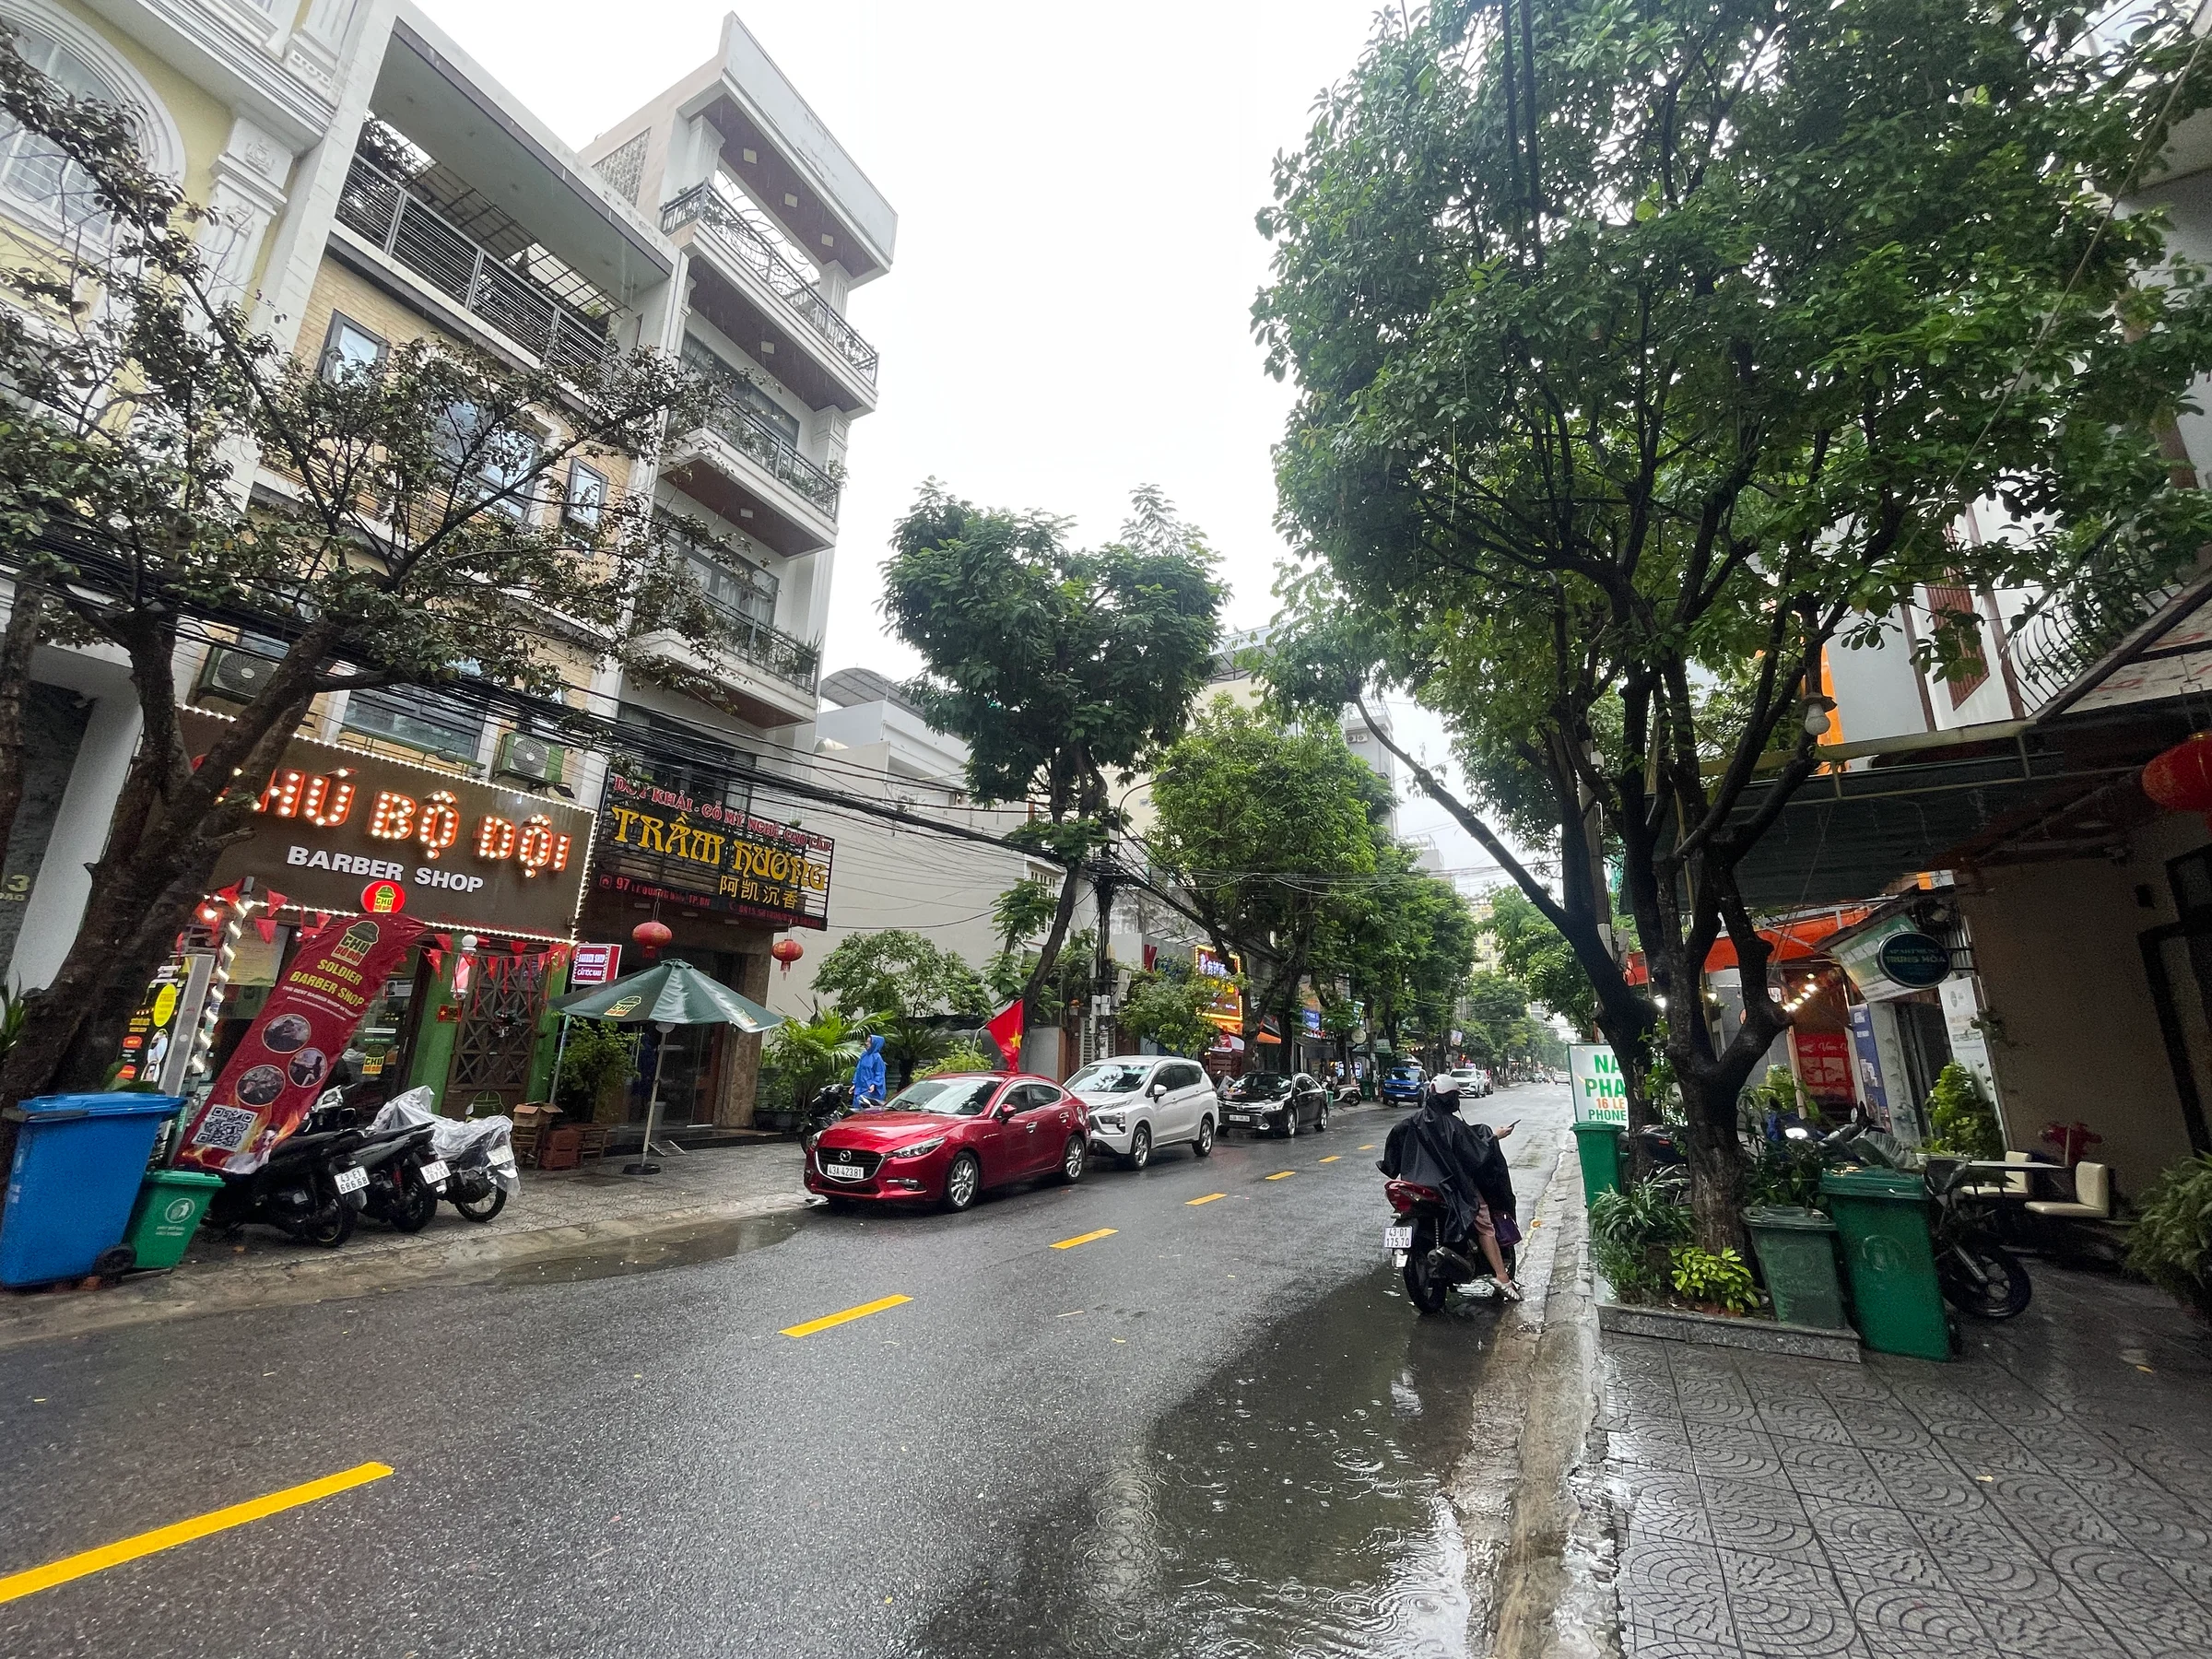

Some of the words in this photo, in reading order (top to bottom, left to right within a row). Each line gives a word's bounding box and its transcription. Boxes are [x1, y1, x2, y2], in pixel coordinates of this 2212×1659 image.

[368, 790, 460, 860] BỘ
[473, 814, 571, 878] ĐỘI
[611, 806, 725, 865] TRẦM
[732, 840, 829, 891] HƯƠNG
[287, 845, 405, 881] BARBER
[414, 866, 484, 893] SHOP
[617, 877, 631, 891] 97
[719, 875, 798, 910] 阿凯沉香
[317, 959, 363, 986] SOLDIER
[289, 971, 339, 994] BARBER
[337, 987, 365, 1007] SHOP
[1584, 1078, 1626, 1098] PHA
[1588, 1110, 1628, 1121] PHONE
[1595, 1098, 1609, 1109] 16
[1386, 1237, 1410, 1247] 175.70
